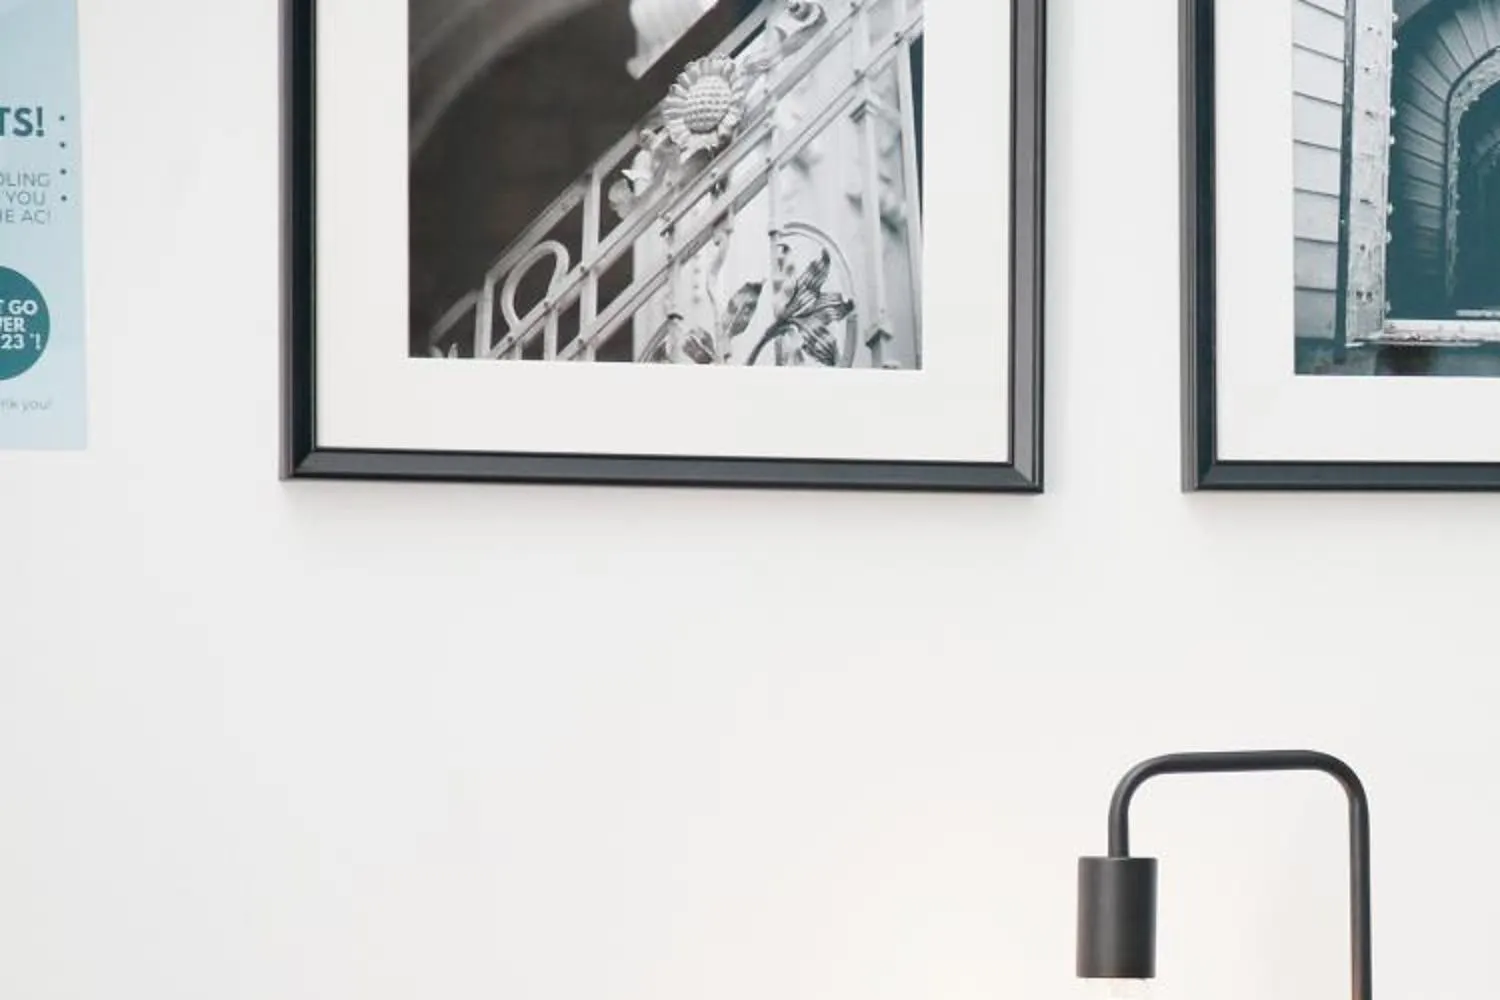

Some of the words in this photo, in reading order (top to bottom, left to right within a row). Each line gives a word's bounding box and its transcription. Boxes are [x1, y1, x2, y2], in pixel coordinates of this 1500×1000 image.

[5, 190, 46, 206] YOU
[8, 299, 38, 315] GO
[1, 333, 25, 350] 23
